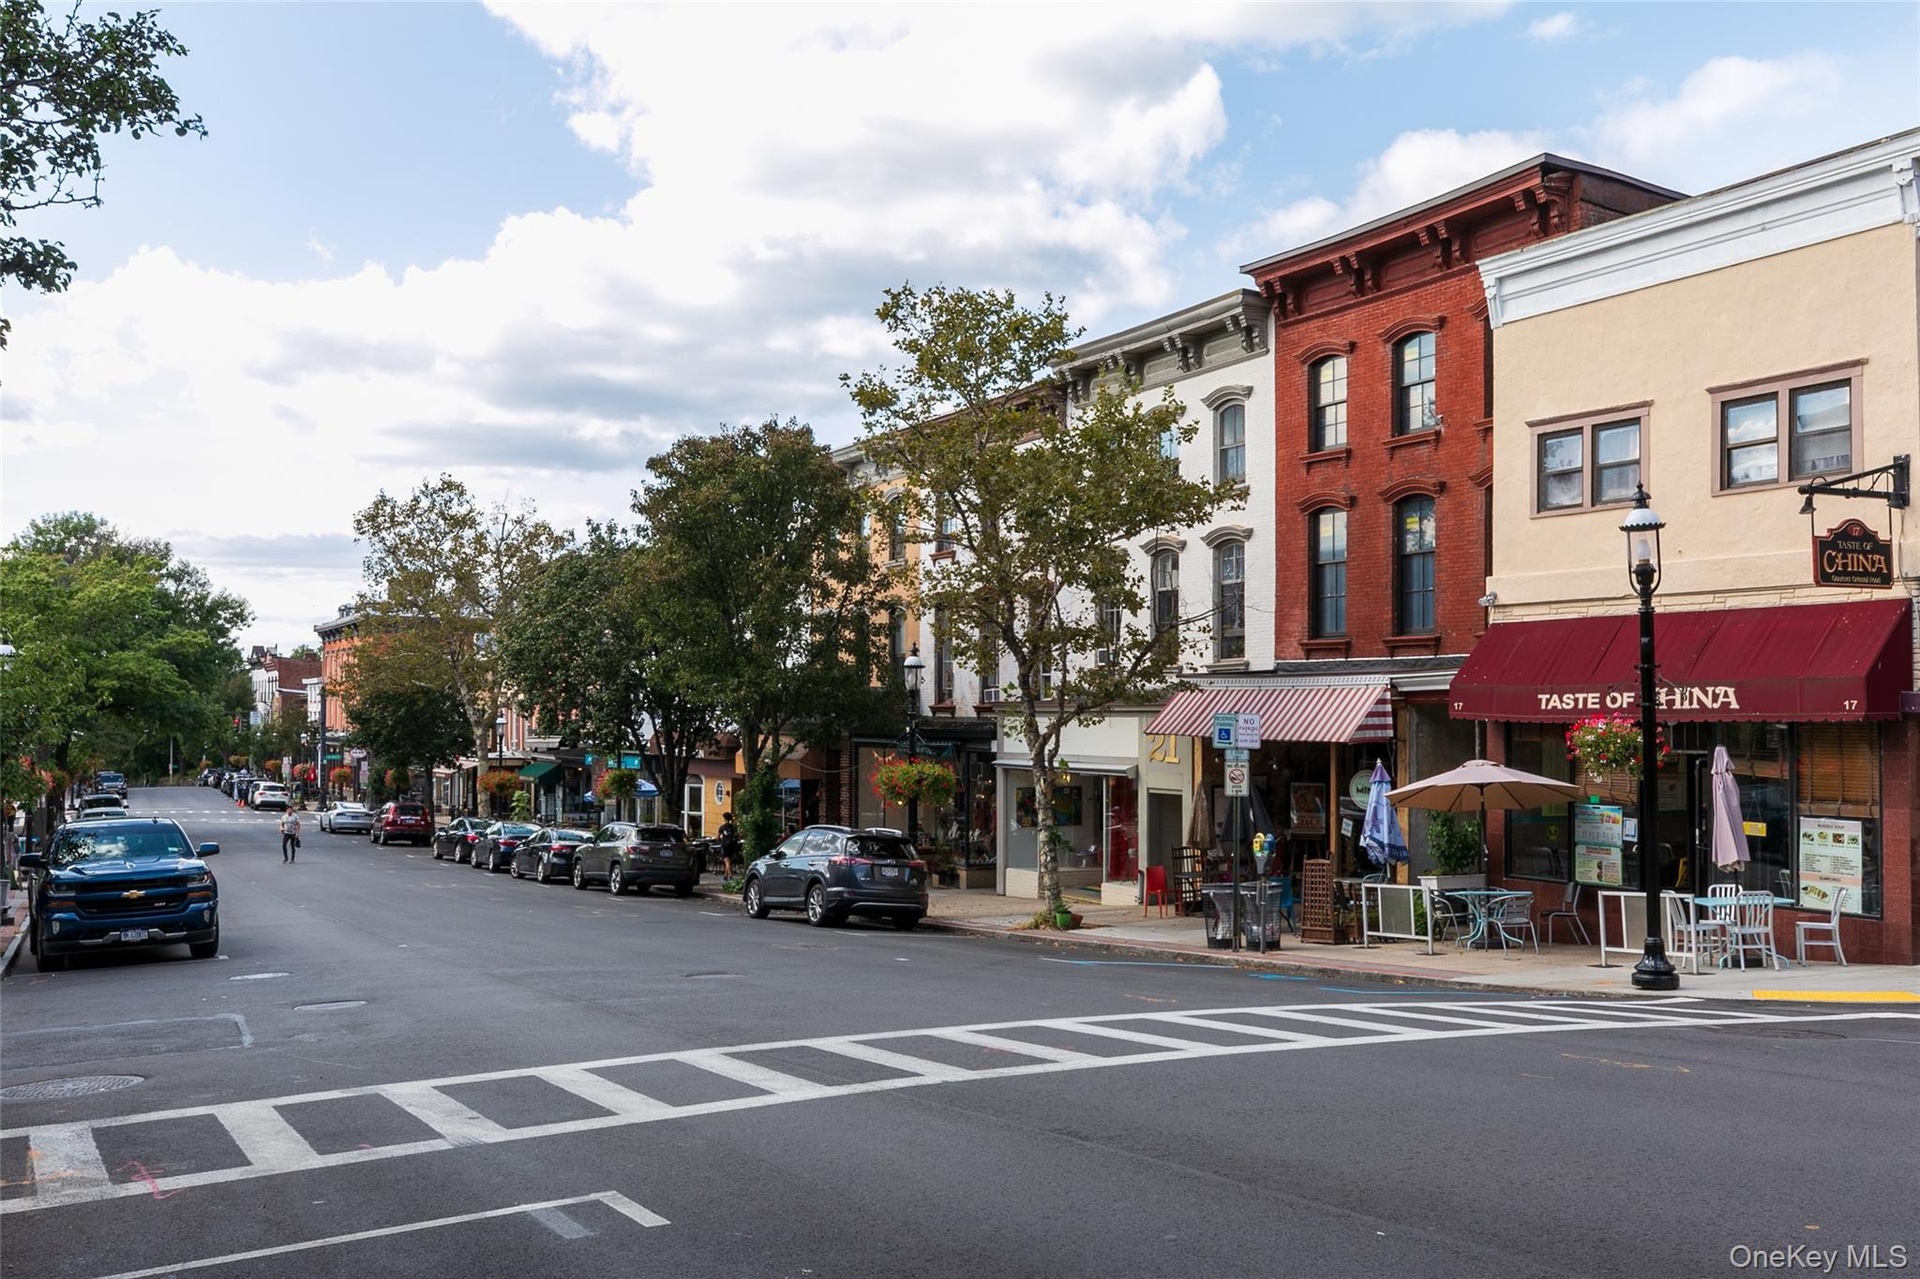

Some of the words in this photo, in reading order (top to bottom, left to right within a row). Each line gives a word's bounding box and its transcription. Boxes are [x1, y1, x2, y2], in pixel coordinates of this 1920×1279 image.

[1852, 527, 1860, 536] 17
[1837, 541, 1861, 550] TASTE
[1863, 542, 1874, 550] OF
[1823, 550, 1888, 573] CHINA
[1538, 693, 1600, 710] TASTE
[1606, 692, 1635, 709] OF
[1654, 686, 1740, 709] HINA
[1453, 702, 1464, 711] 17
[1843, 700, 1858, 710] 17
[1147, 734, 1180, 763] 21
